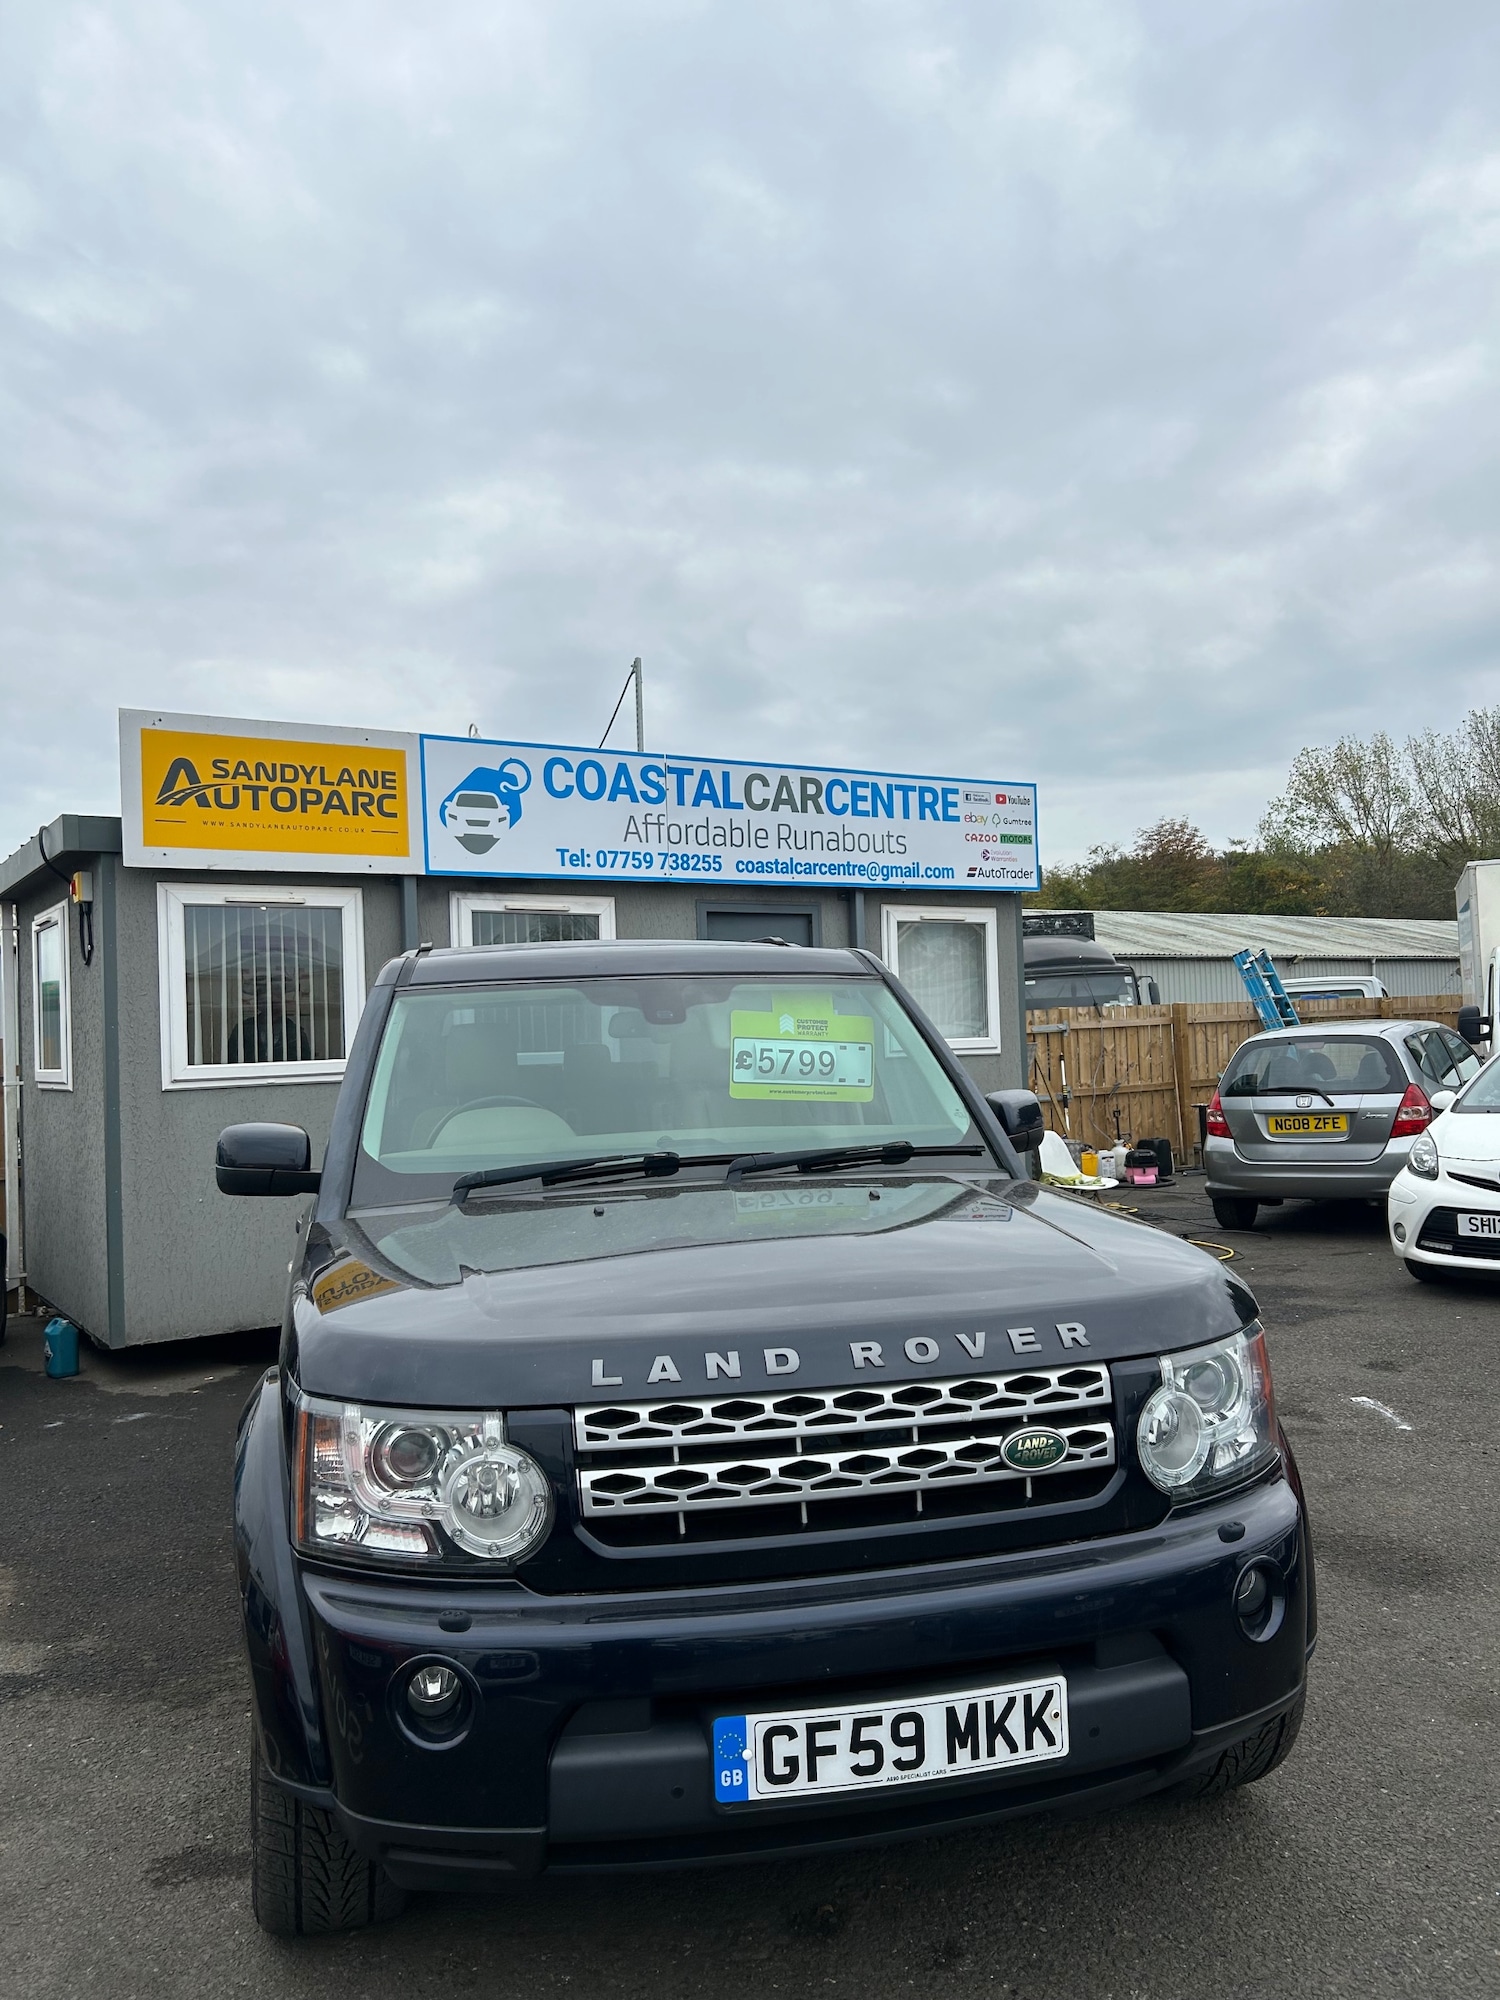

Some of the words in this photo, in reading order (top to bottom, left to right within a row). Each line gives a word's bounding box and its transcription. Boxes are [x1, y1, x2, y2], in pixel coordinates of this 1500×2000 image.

[212, 758, 397, 791] SANDYLANE
[155, 757, 398, 818] AUTOPARC
[543, 757, 960, 822] COASTALCARCENTRE
[1008, 795, 1030, 805] YouTube
[202, 820, 366, 833] WWW.SANDYLANEAUTOPARC.CO.UK
[964, 812, 988, 826] ebay
[1003, 817, 1032, 826] Gumtree
[623, 813, 769, 849] Affordable
[777, 823, 907, 855] Runabouts
[556, 848, 591, 869] Tel:
[596, 850, 654, 870] 07759
[658, 852, 722, 872] 738255
[735, 857, 955, 881] coastalcarcentre@gmail.com
[977, 867, 1034, 879] AutoTrader
[796, 1024, 829, 1032] PROTECT
[735, 1047, 835, 1076] £5799
[1274, 1118, 1310, 1131] NG08
[1313, 1116, 1341, 1130] ZFE
[590, 1347, 801, 1387] LAND
[849, 1321, 1092, 1369] ROVER
[1017, 1436, 1047, 1451] LAND
[1021, 1446, 1057, 1461] ROVER
[762, 1710, 926, 1786] GF59
[945, 1689, 1057, 1765] MKK
[720, 1769, 743, 1788] GB
[900, 1770, 931, 1781] SPECIALIST
[931, 1768, 947, 1777] CARS
